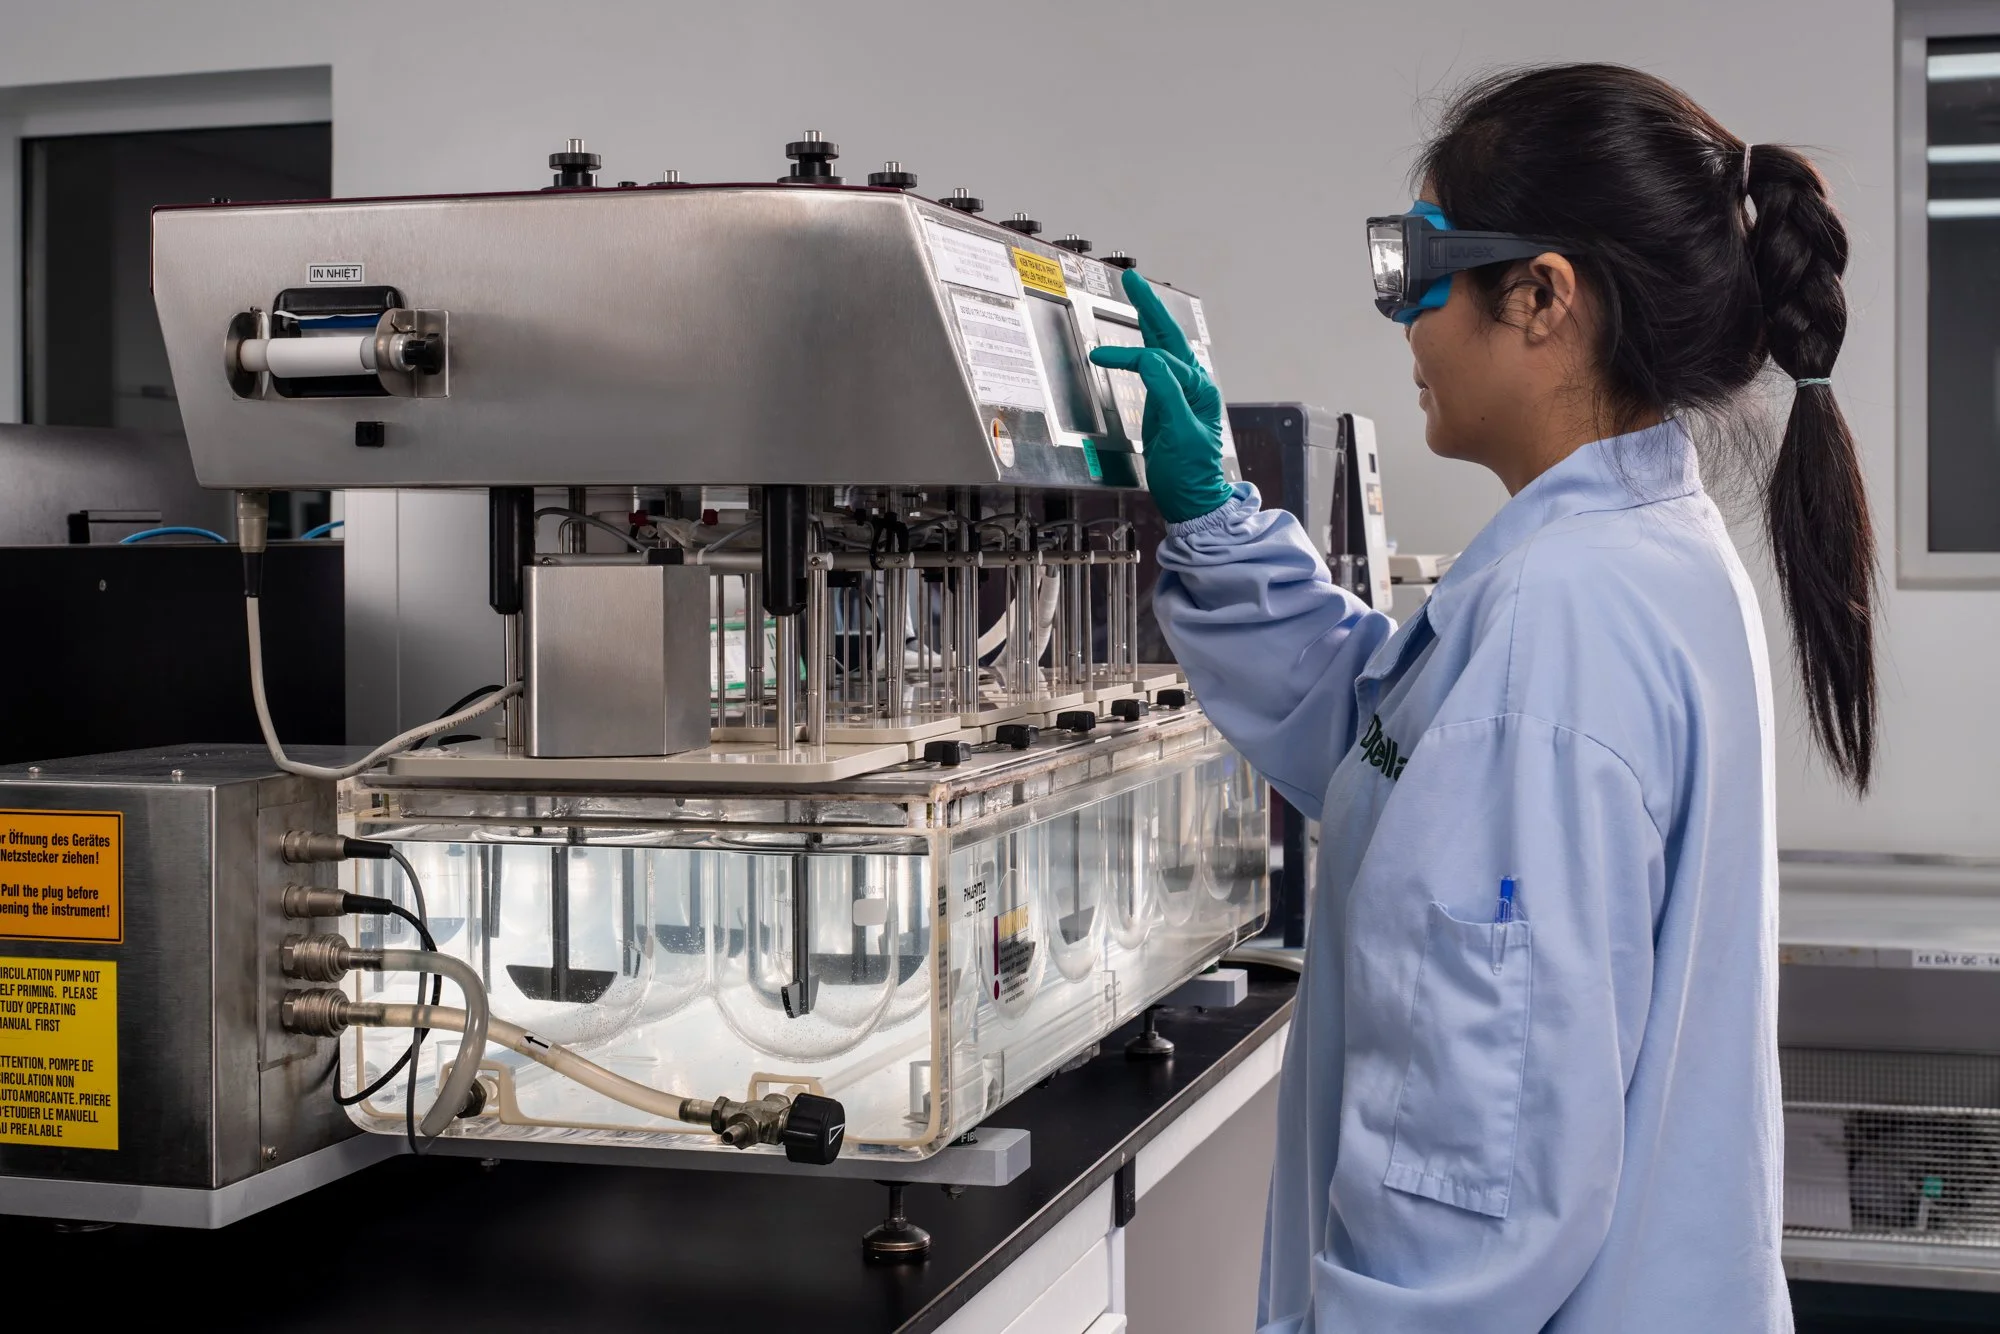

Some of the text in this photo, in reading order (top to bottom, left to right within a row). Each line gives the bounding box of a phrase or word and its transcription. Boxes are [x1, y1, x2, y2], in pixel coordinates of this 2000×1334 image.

[313, 266, 358, 281] IN NHIỆT
[9, 829, 48, 849] Öffnung
[51, 833, 69, 846] des
[72, 833, 110, 848] Gerätes
[0, 849, 99, 865] Netzstecker ziehen!
[1, 883, 99, 901] Pull the plug before
[32, 902, 48, 916] the
[51, 903, 110, 918] instrument!
[975, 896, 987, 914] TEST
[55, 969, 80, 983] PUMP
[82, 970, 100, 983] NOT
[17, 985, 57, 998] PRIMING.
[62, 987, 98, 1000] PLEASE
[26, 1002, 76, 1016] OPERATING
[35, 1019, 61, 1032] FIRST
[0, 1055, 94, 1073] TTENTION, POMPE DE
[0, 1072, 75, 1088] IRCULATION NON
[79, 1093, 111, 1107] PRIERE
[0, 1105, 99, 1123] 'ETUDIER LE MANUELL
[10, 1123, 63, 1138] PREALABLE
